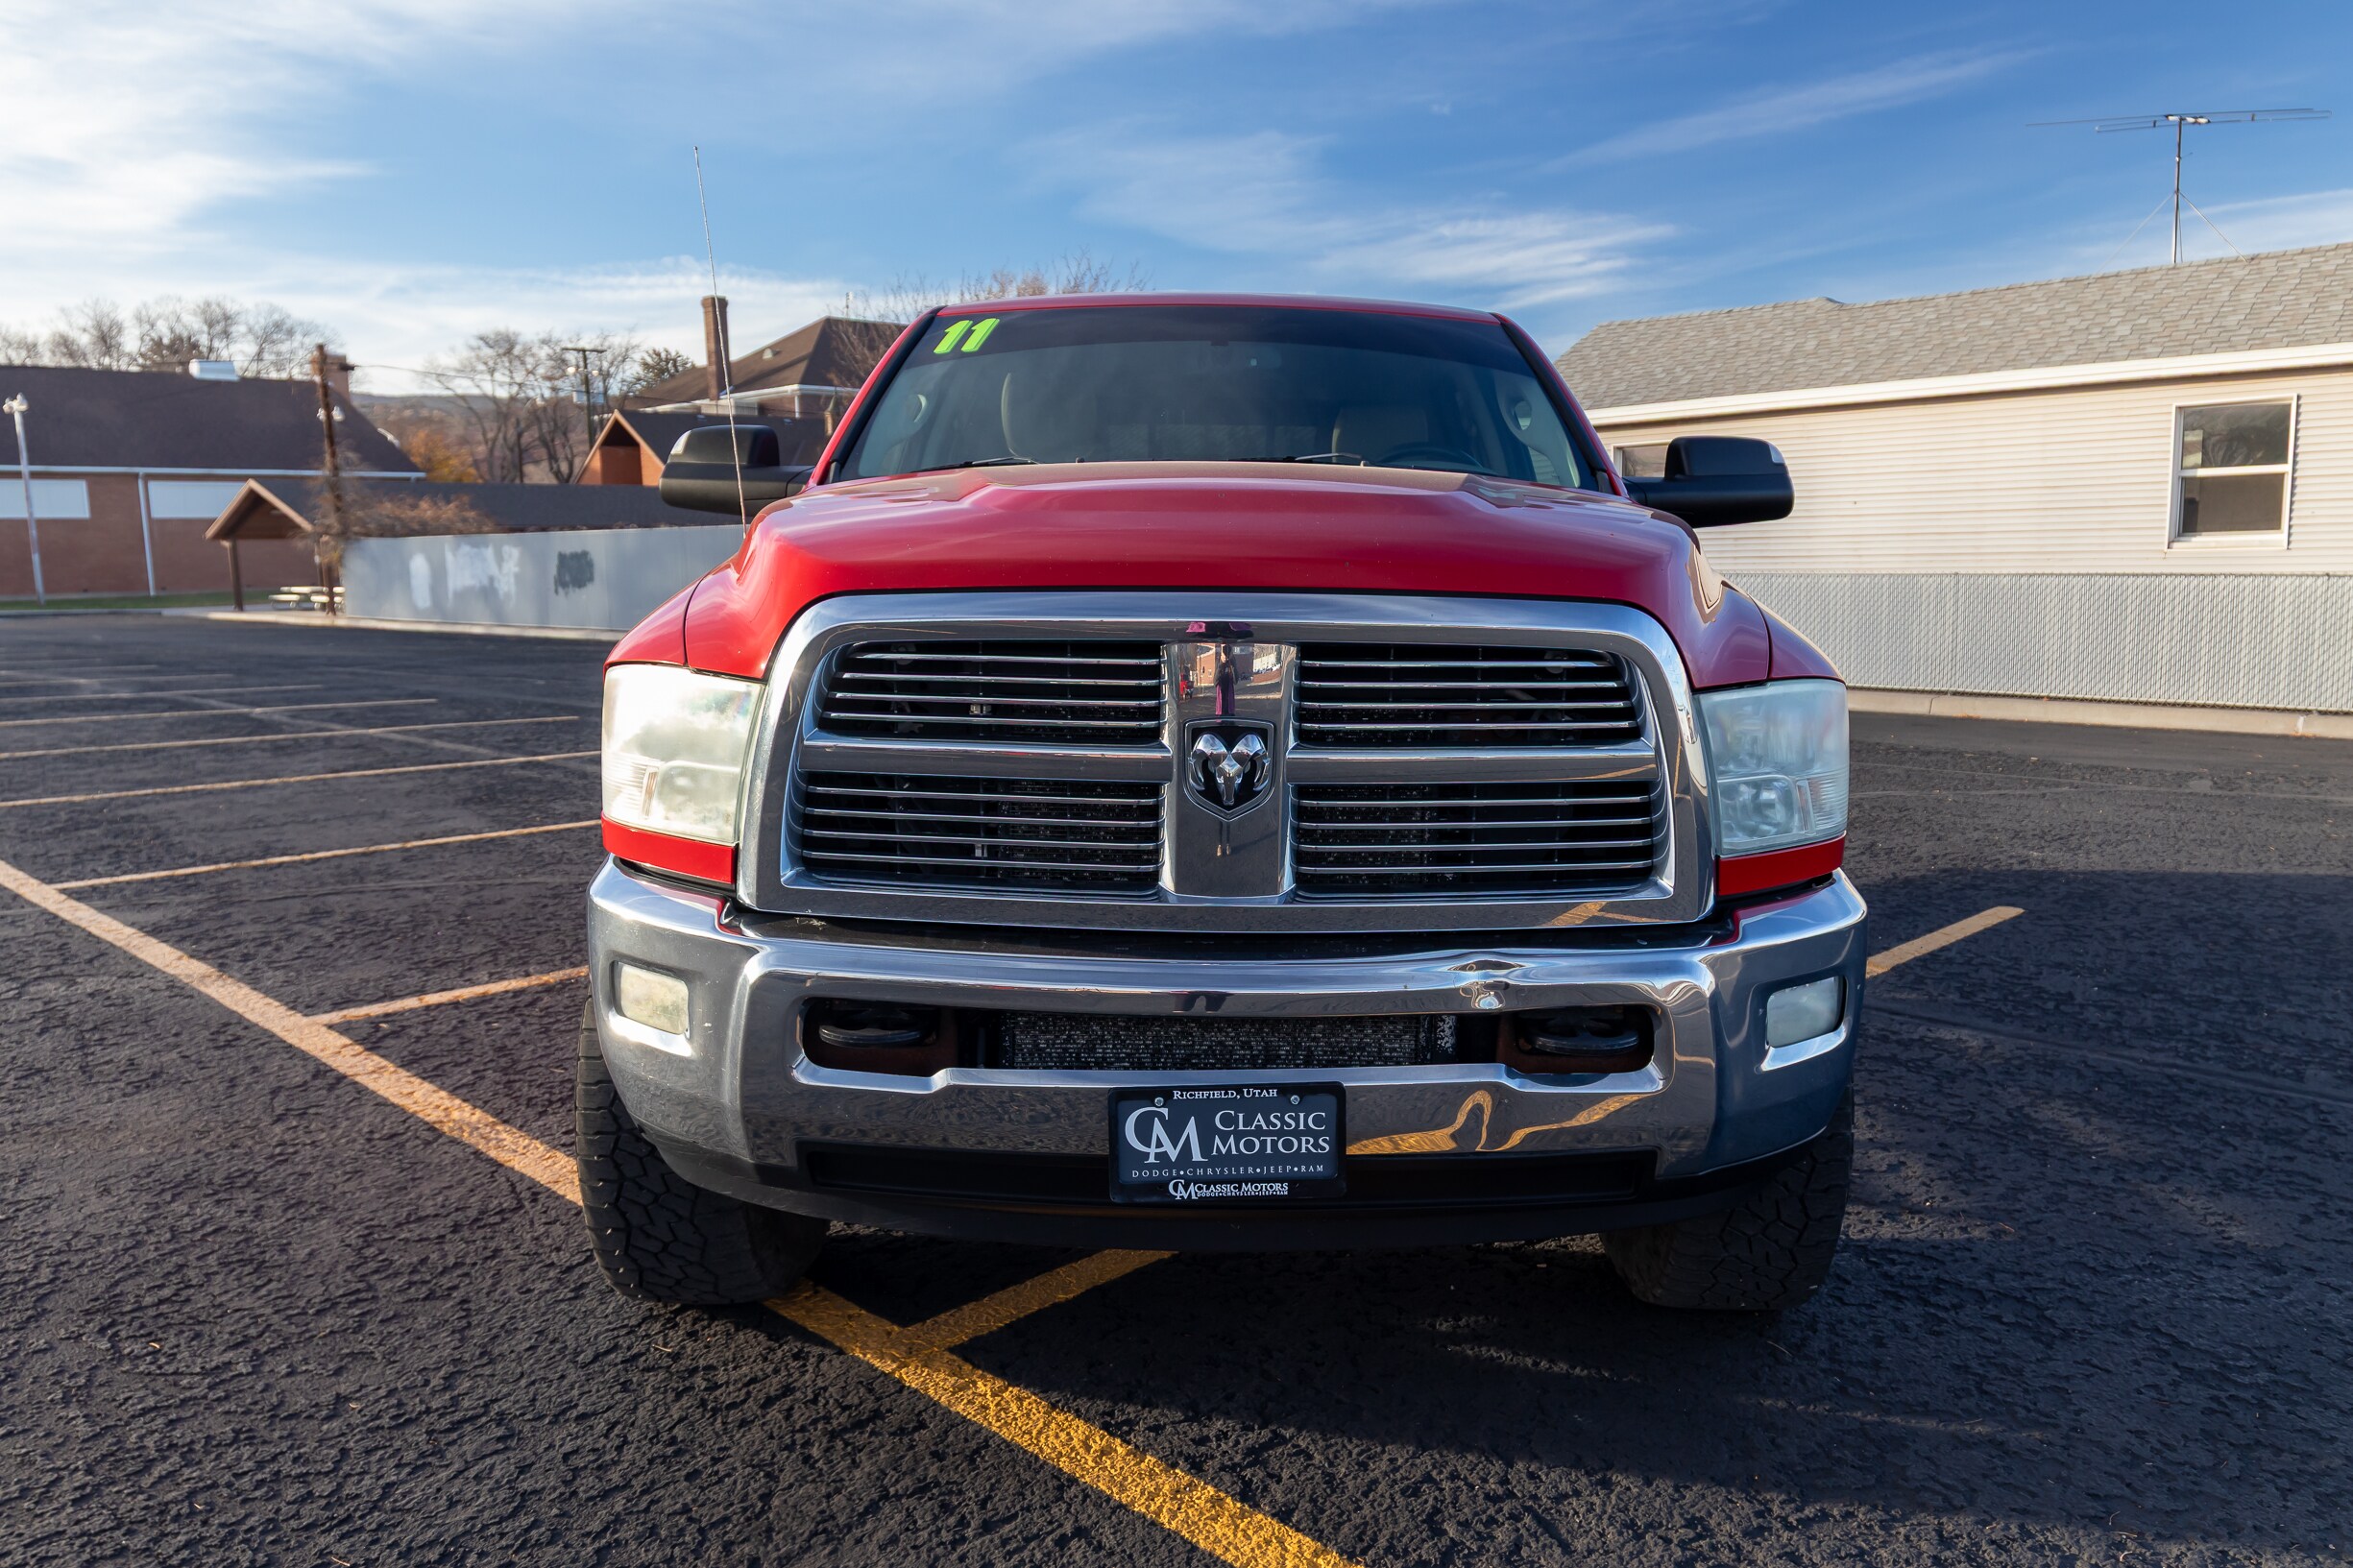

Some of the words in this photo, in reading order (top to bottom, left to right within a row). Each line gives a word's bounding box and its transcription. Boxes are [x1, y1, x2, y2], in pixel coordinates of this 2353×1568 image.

[934, 318, 1000, 354] 11
[1173, 1090, 1240, 1099] RICHFIELD,
[1243, 1088, 1278, 1098] UTAH
[1214, 1110, 1326, 1131] CLASSIC
[1125, 1106, 1208, 1164] CM
[1211, 1134, 1330, 1156] MOTORS
[1168, 1179, 1199, 1200] CM
[1195, 1183, 1239, 1193] CLASSIC
[1241, 1182, 1289, 1192] MOTORS
